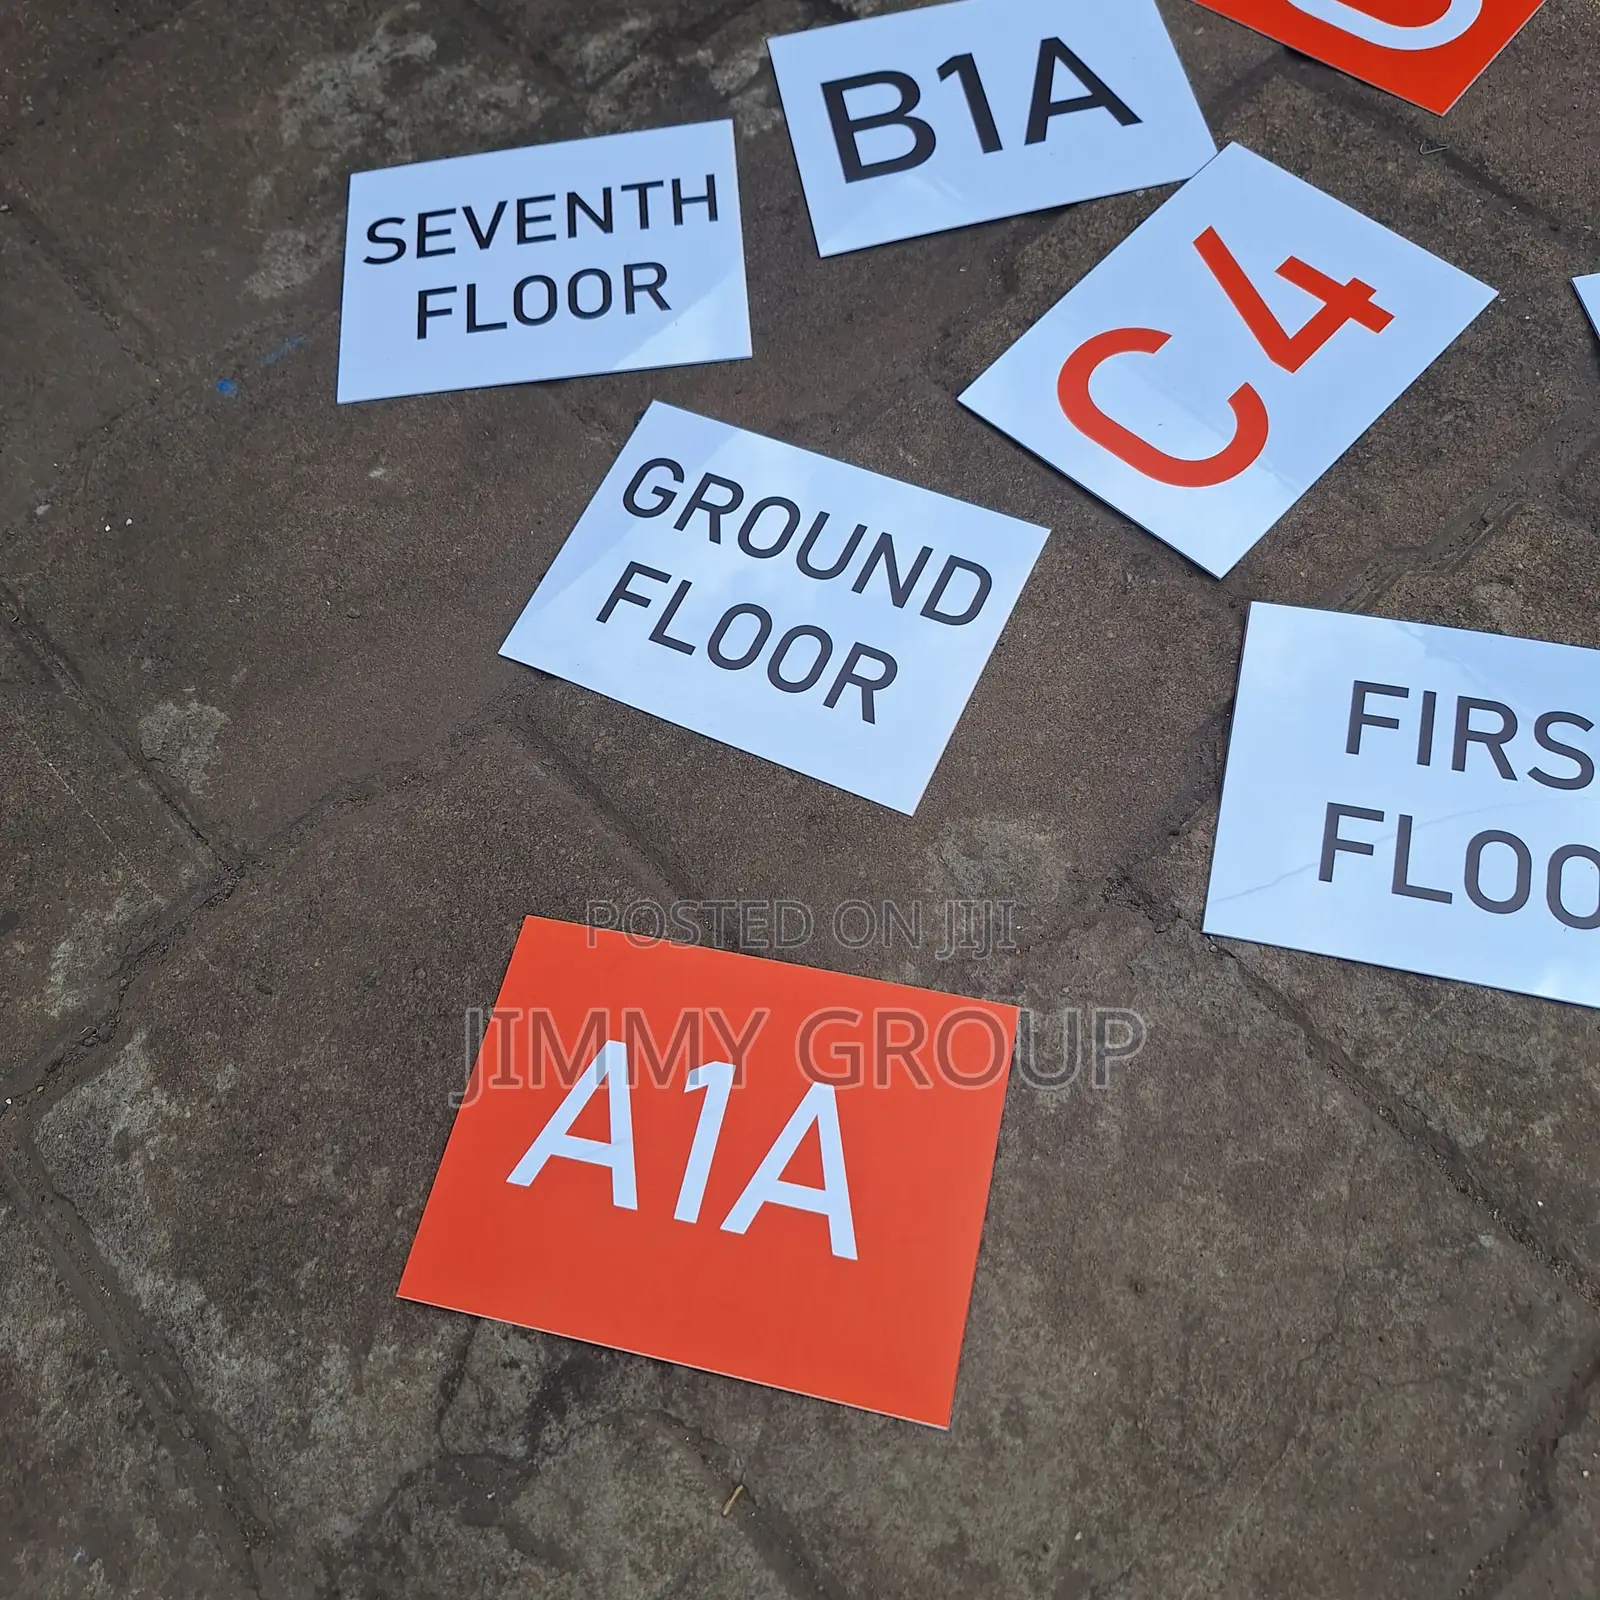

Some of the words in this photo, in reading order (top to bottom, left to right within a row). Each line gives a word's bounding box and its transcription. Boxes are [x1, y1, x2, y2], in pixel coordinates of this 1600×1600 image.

[820, 36, 1143, 184] B1A
[363, 173, 719, 266] SEVENTH
[416, 261, 671, 340] FLOOR
[1057, 225, 1395, 488] C4
[622, 457, 993, 627] GROUND
[595, 561, 899, 725] FLOOR
[1345, 680, 1595, 791] FIRS
[1318, 801, 1600, 930] FLOO
[505, 1039, 859, 1262] A1A
